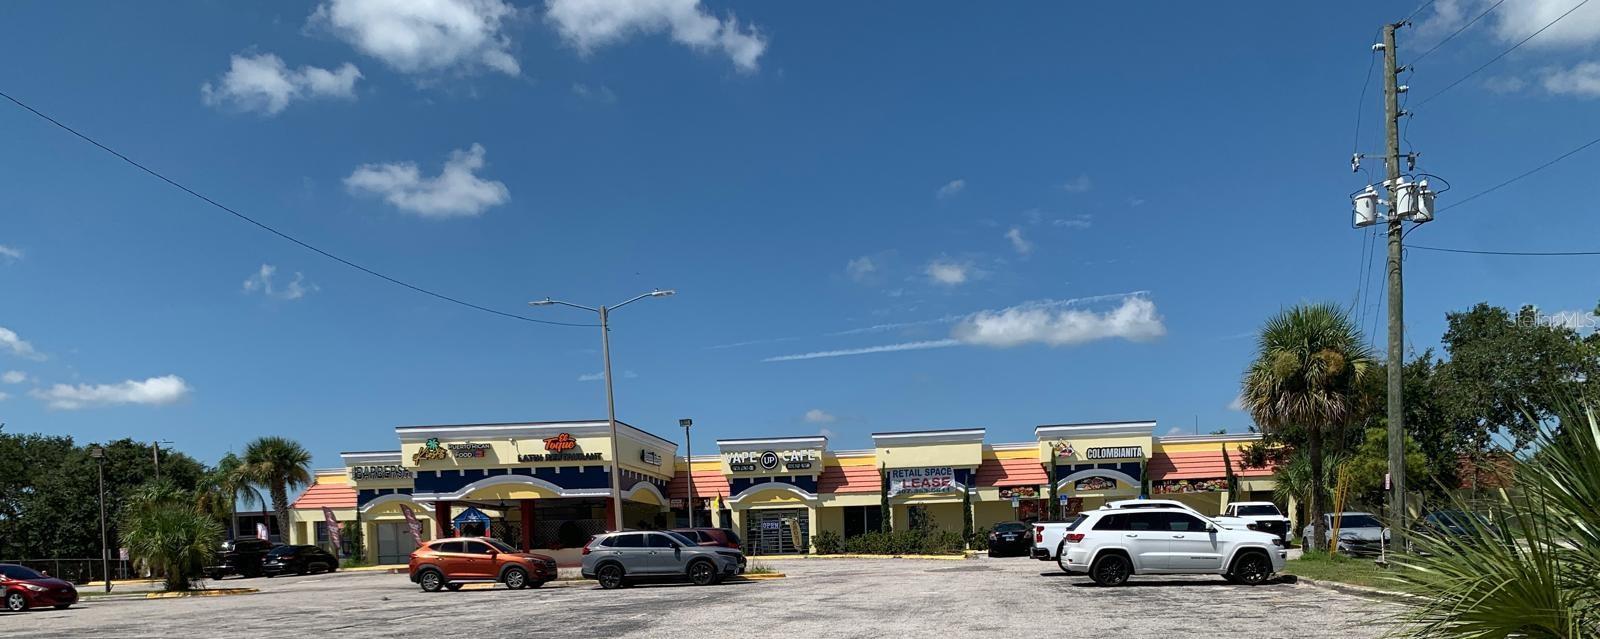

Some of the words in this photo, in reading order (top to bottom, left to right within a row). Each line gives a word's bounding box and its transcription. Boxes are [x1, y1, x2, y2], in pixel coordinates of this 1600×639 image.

[543, 438, 576, 452] Toque
[517, 454, 544, 462] LATIN
[725, 451, 757, 464] VAPE
[763, 456, 775, 465] UP
[782, 449, 815, 462] CAFE
[1087, 447, 1142, 459] COLOMBIANITA
[893, 469, 922, 478] RETAIL
[925, 467, 952, 477] SPACE
[902, 476, 951, 489] LEASE
